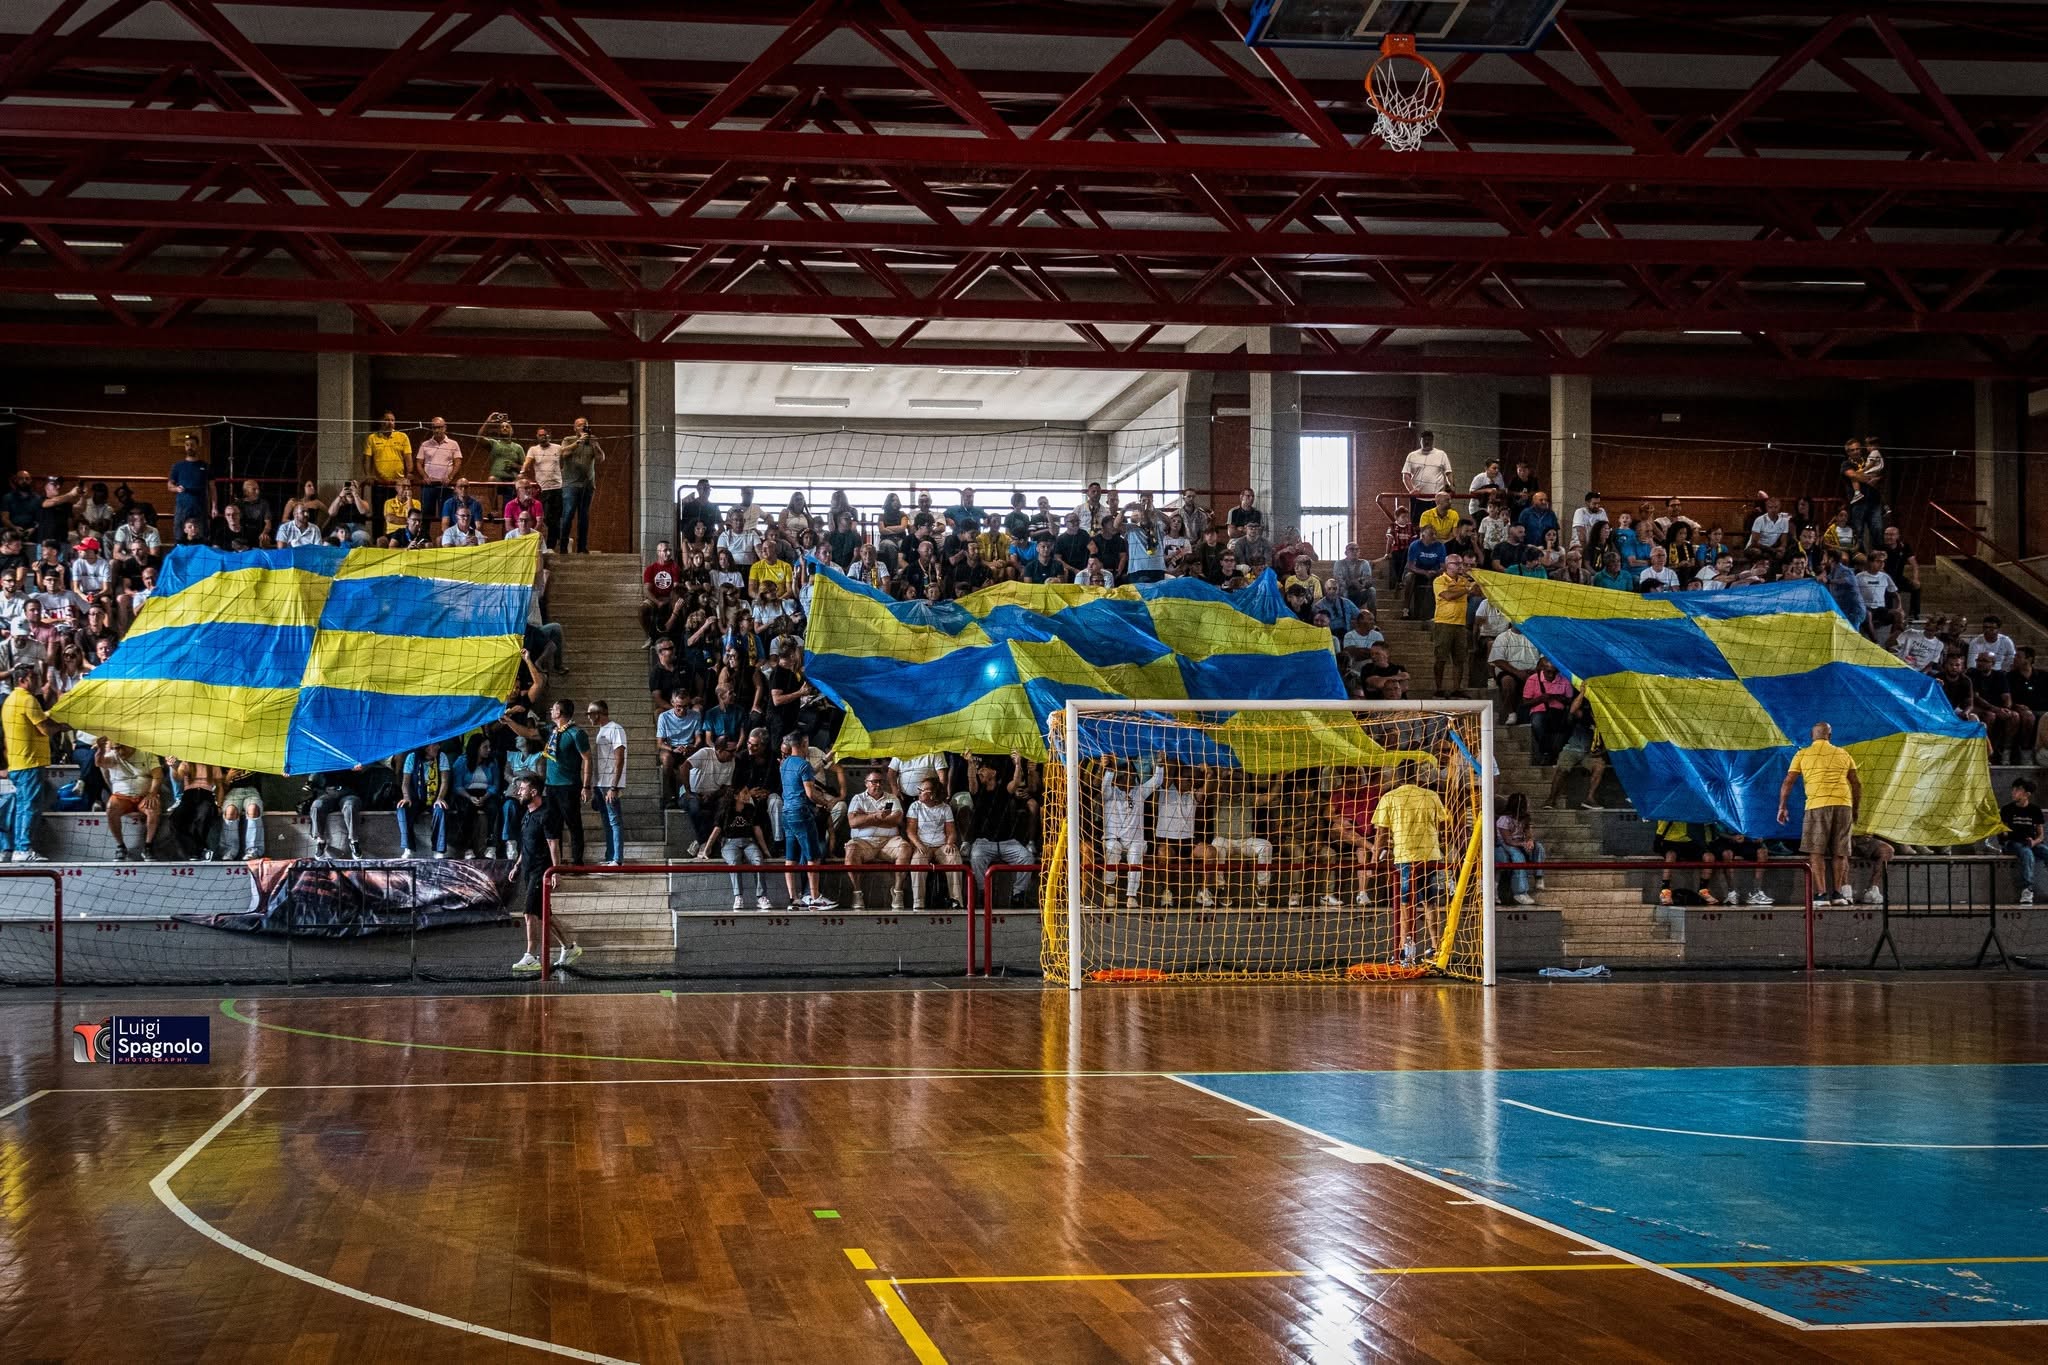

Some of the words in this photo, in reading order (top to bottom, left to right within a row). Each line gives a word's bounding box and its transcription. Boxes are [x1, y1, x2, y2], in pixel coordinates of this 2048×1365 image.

[171, 868, 194, 876] 342
[768, 918, 790, 926] 392
[822, 918, 844, 926] 393
[930, 917, 952, 925] 395
